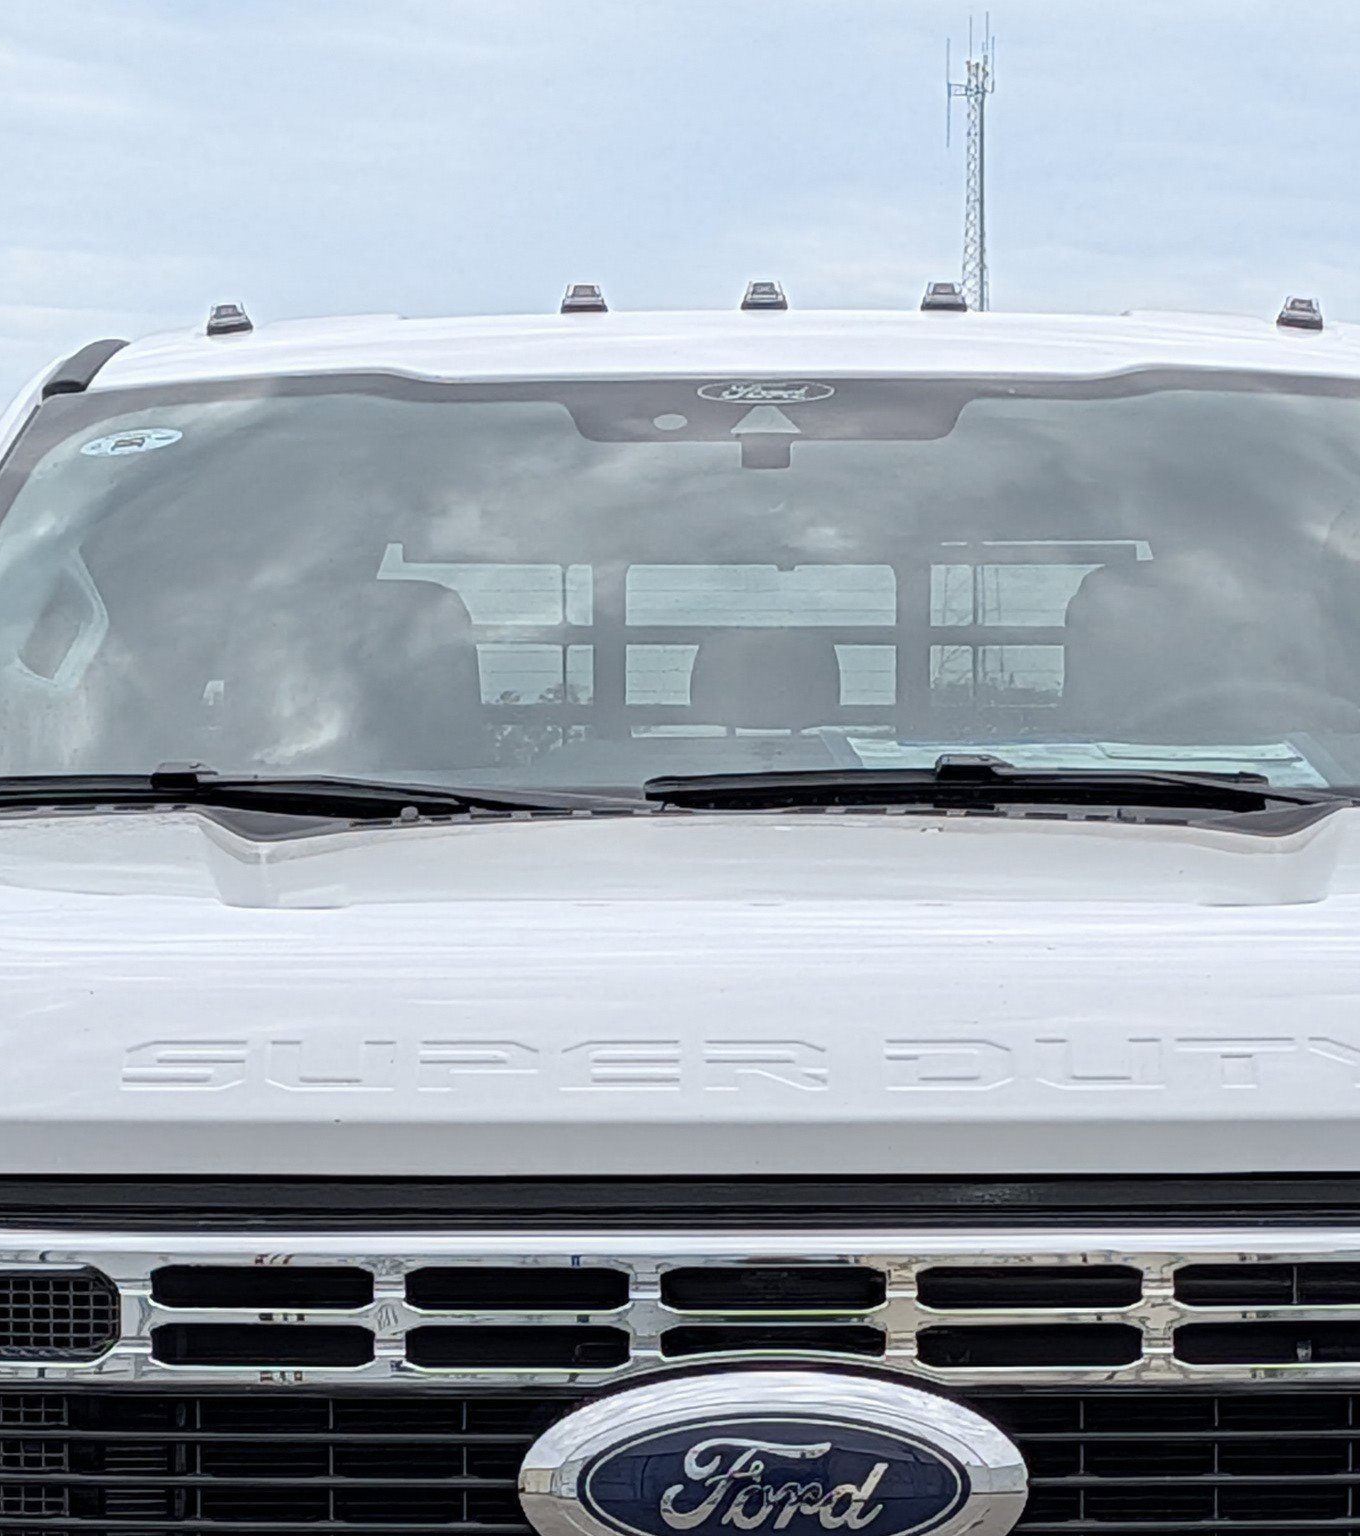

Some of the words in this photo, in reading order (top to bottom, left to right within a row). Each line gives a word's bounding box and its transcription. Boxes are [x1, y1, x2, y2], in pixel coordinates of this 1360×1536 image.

[722, 383, 809, 400] Ford
[120, 1039, 830, 1092] SUPER
[660, 1437, 889, 1530] Ford
